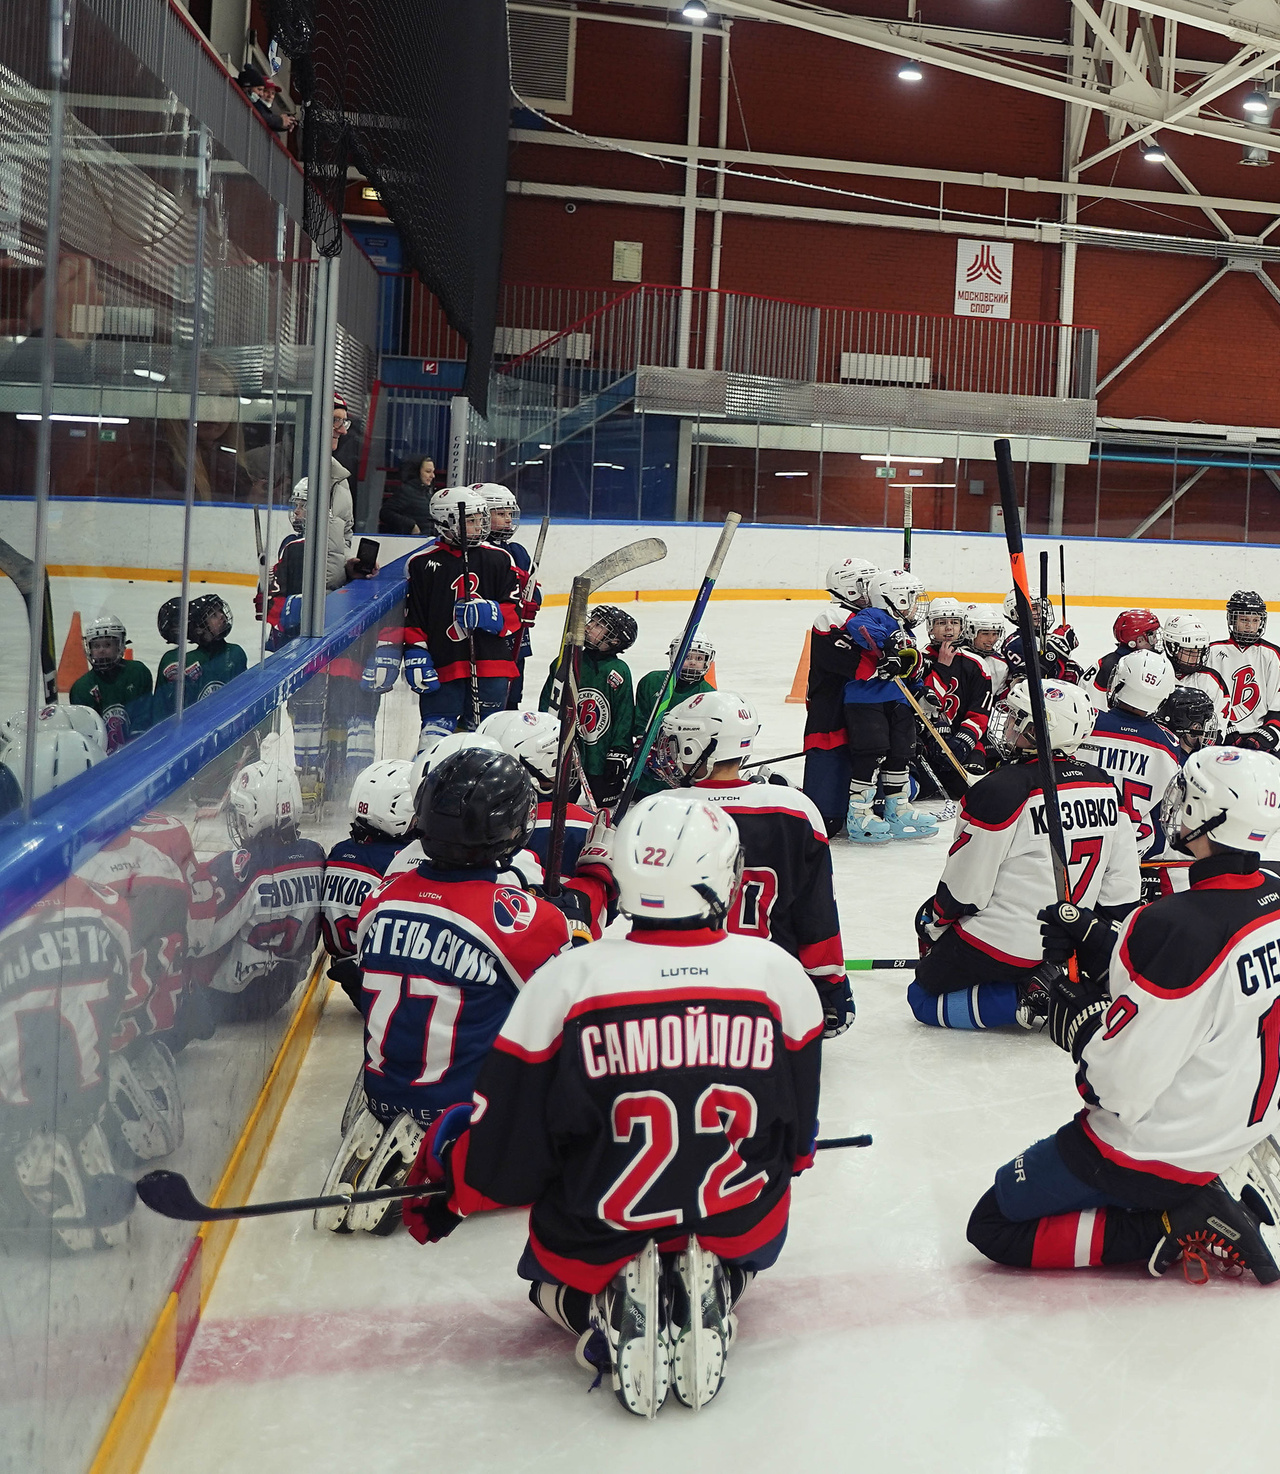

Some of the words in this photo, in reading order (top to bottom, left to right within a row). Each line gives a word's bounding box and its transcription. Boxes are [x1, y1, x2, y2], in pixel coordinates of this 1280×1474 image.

[957, 290, 1009, 303] МОСКОВСКИЙ
[970, 303, 994, 314] СПОРТ
[1144, 673, 1158, 685] 55
[1099, 746, 1149, 776] ТИТУХ
[357, 801, 368, 814] 88
[1030, 797, 1118, 836] КЗОВКО
[643, 846, 667, 867] 22
[1068, 836, 1104, 906] 7
[418, 891, 443, 900] LUTCH
[1257, 892, 1280, 906] LUTCH
[661, 966, 709, 978] LUTCH
[361, 968, 465, 1087] 77
[581, 1005, 775, 1080] САМОЙЛОВ
[598, 1084, 769, 1232] 22
